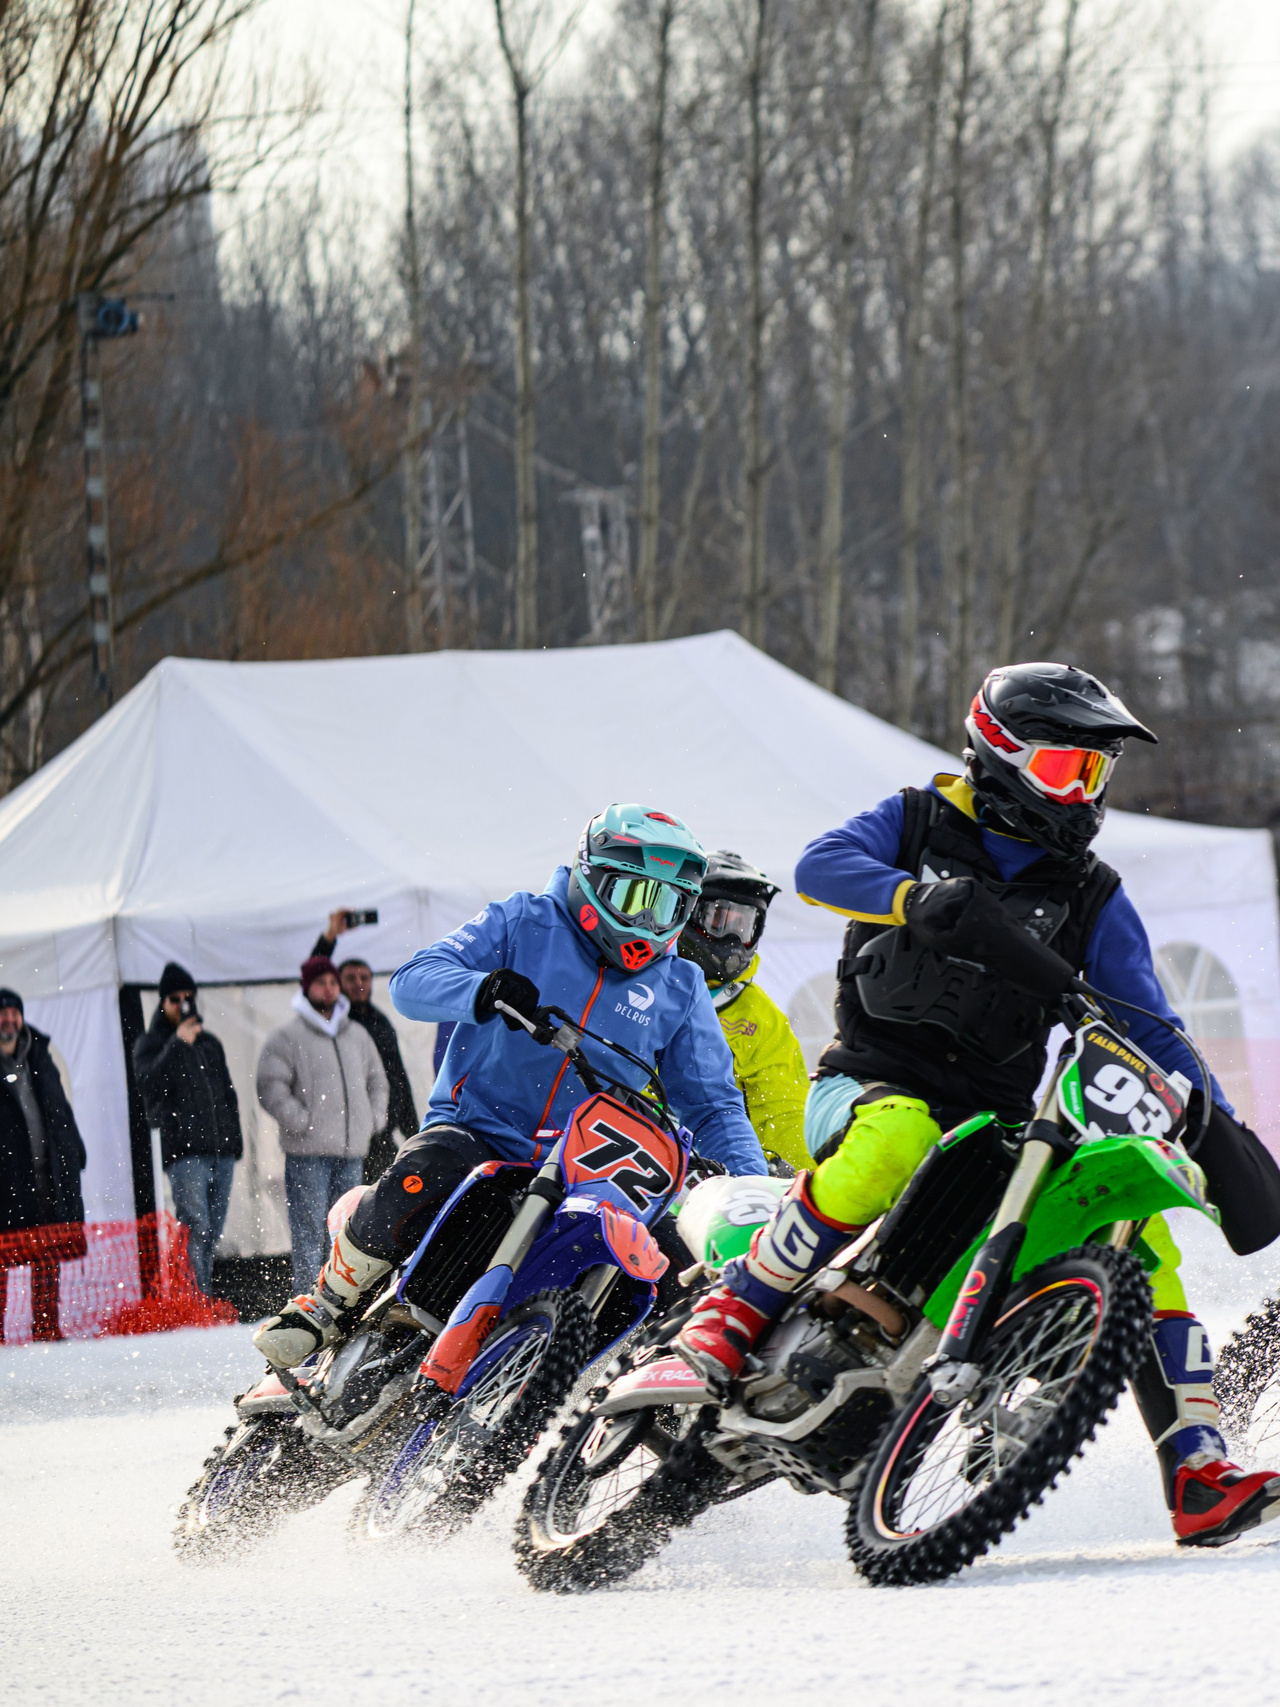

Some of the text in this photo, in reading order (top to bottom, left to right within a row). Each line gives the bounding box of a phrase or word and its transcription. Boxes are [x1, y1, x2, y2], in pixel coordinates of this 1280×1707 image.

[614, 1002, 651, 1027] DELRUS
[1087, 1032, 1148, 1074] FALIN PAVEL
[1084, 1063, 1173, 1140] 93
[572, 1118, 673, 1215] 72
